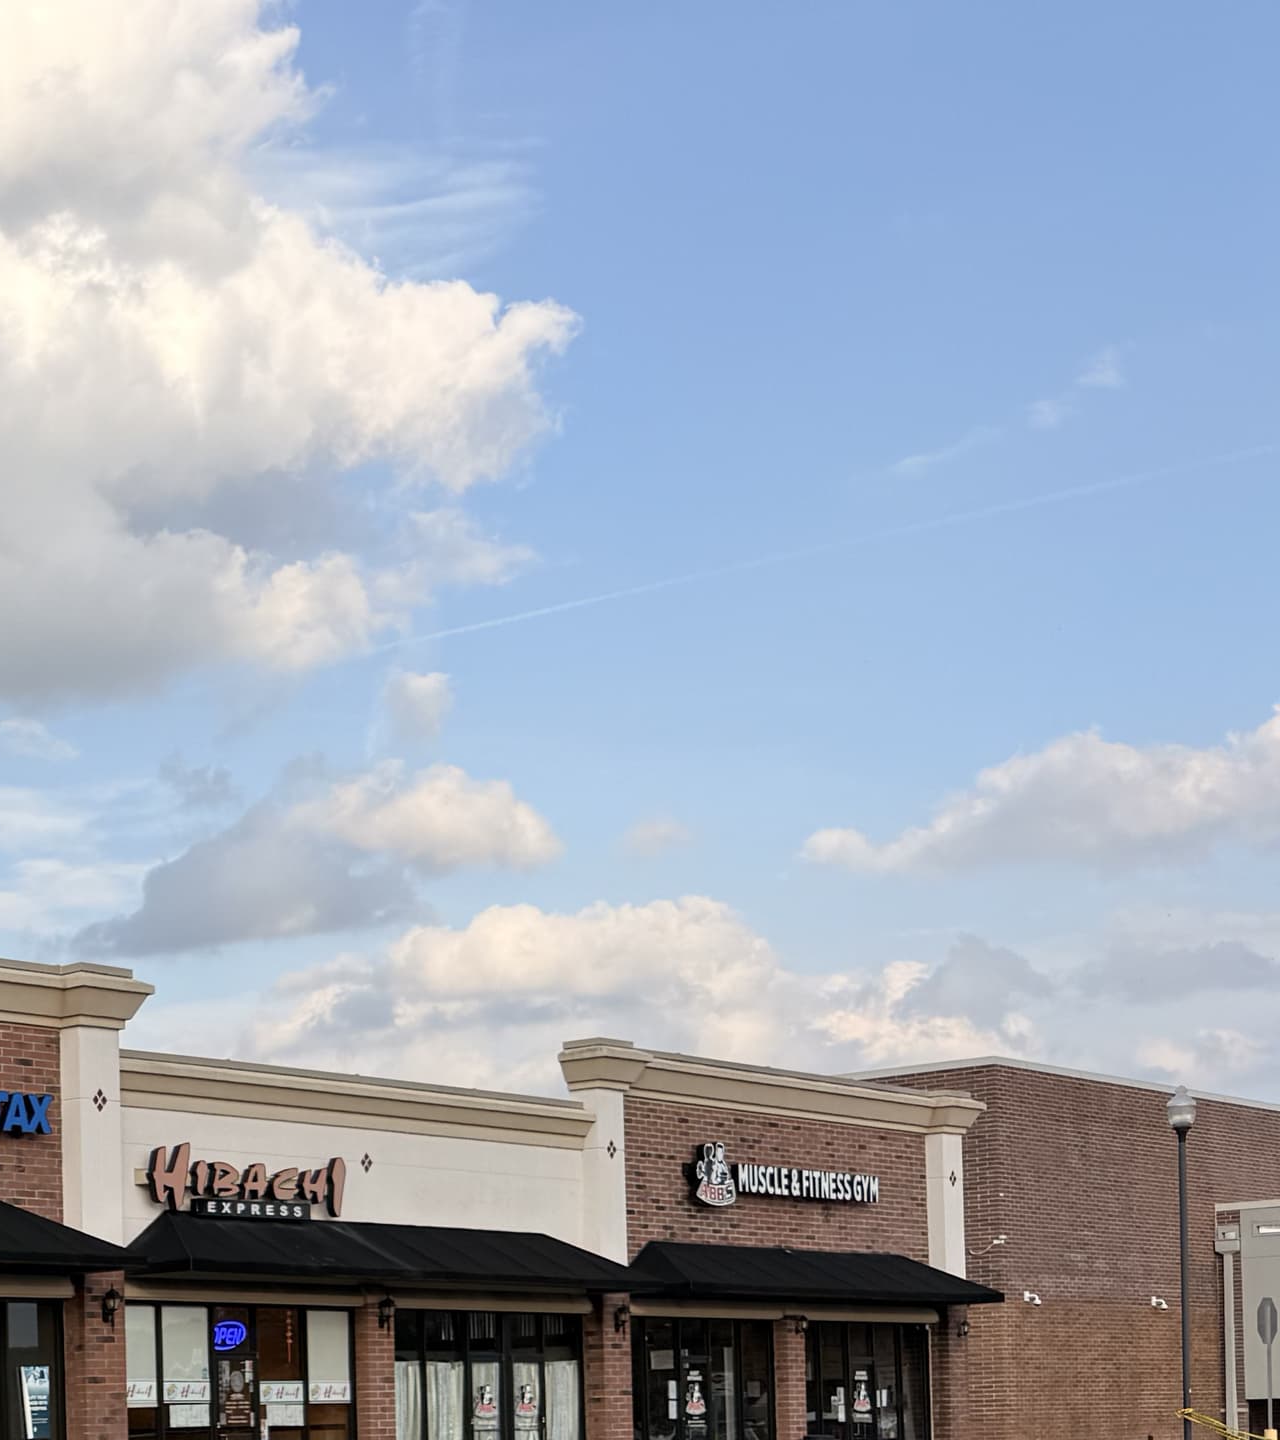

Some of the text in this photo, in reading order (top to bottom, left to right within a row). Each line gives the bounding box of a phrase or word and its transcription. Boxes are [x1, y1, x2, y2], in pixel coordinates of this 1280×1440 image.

[738, 1163, 879, 1203] MUSCLE & FITNESS GYM
[206, 1201, 304, 1218] EXPRESS
